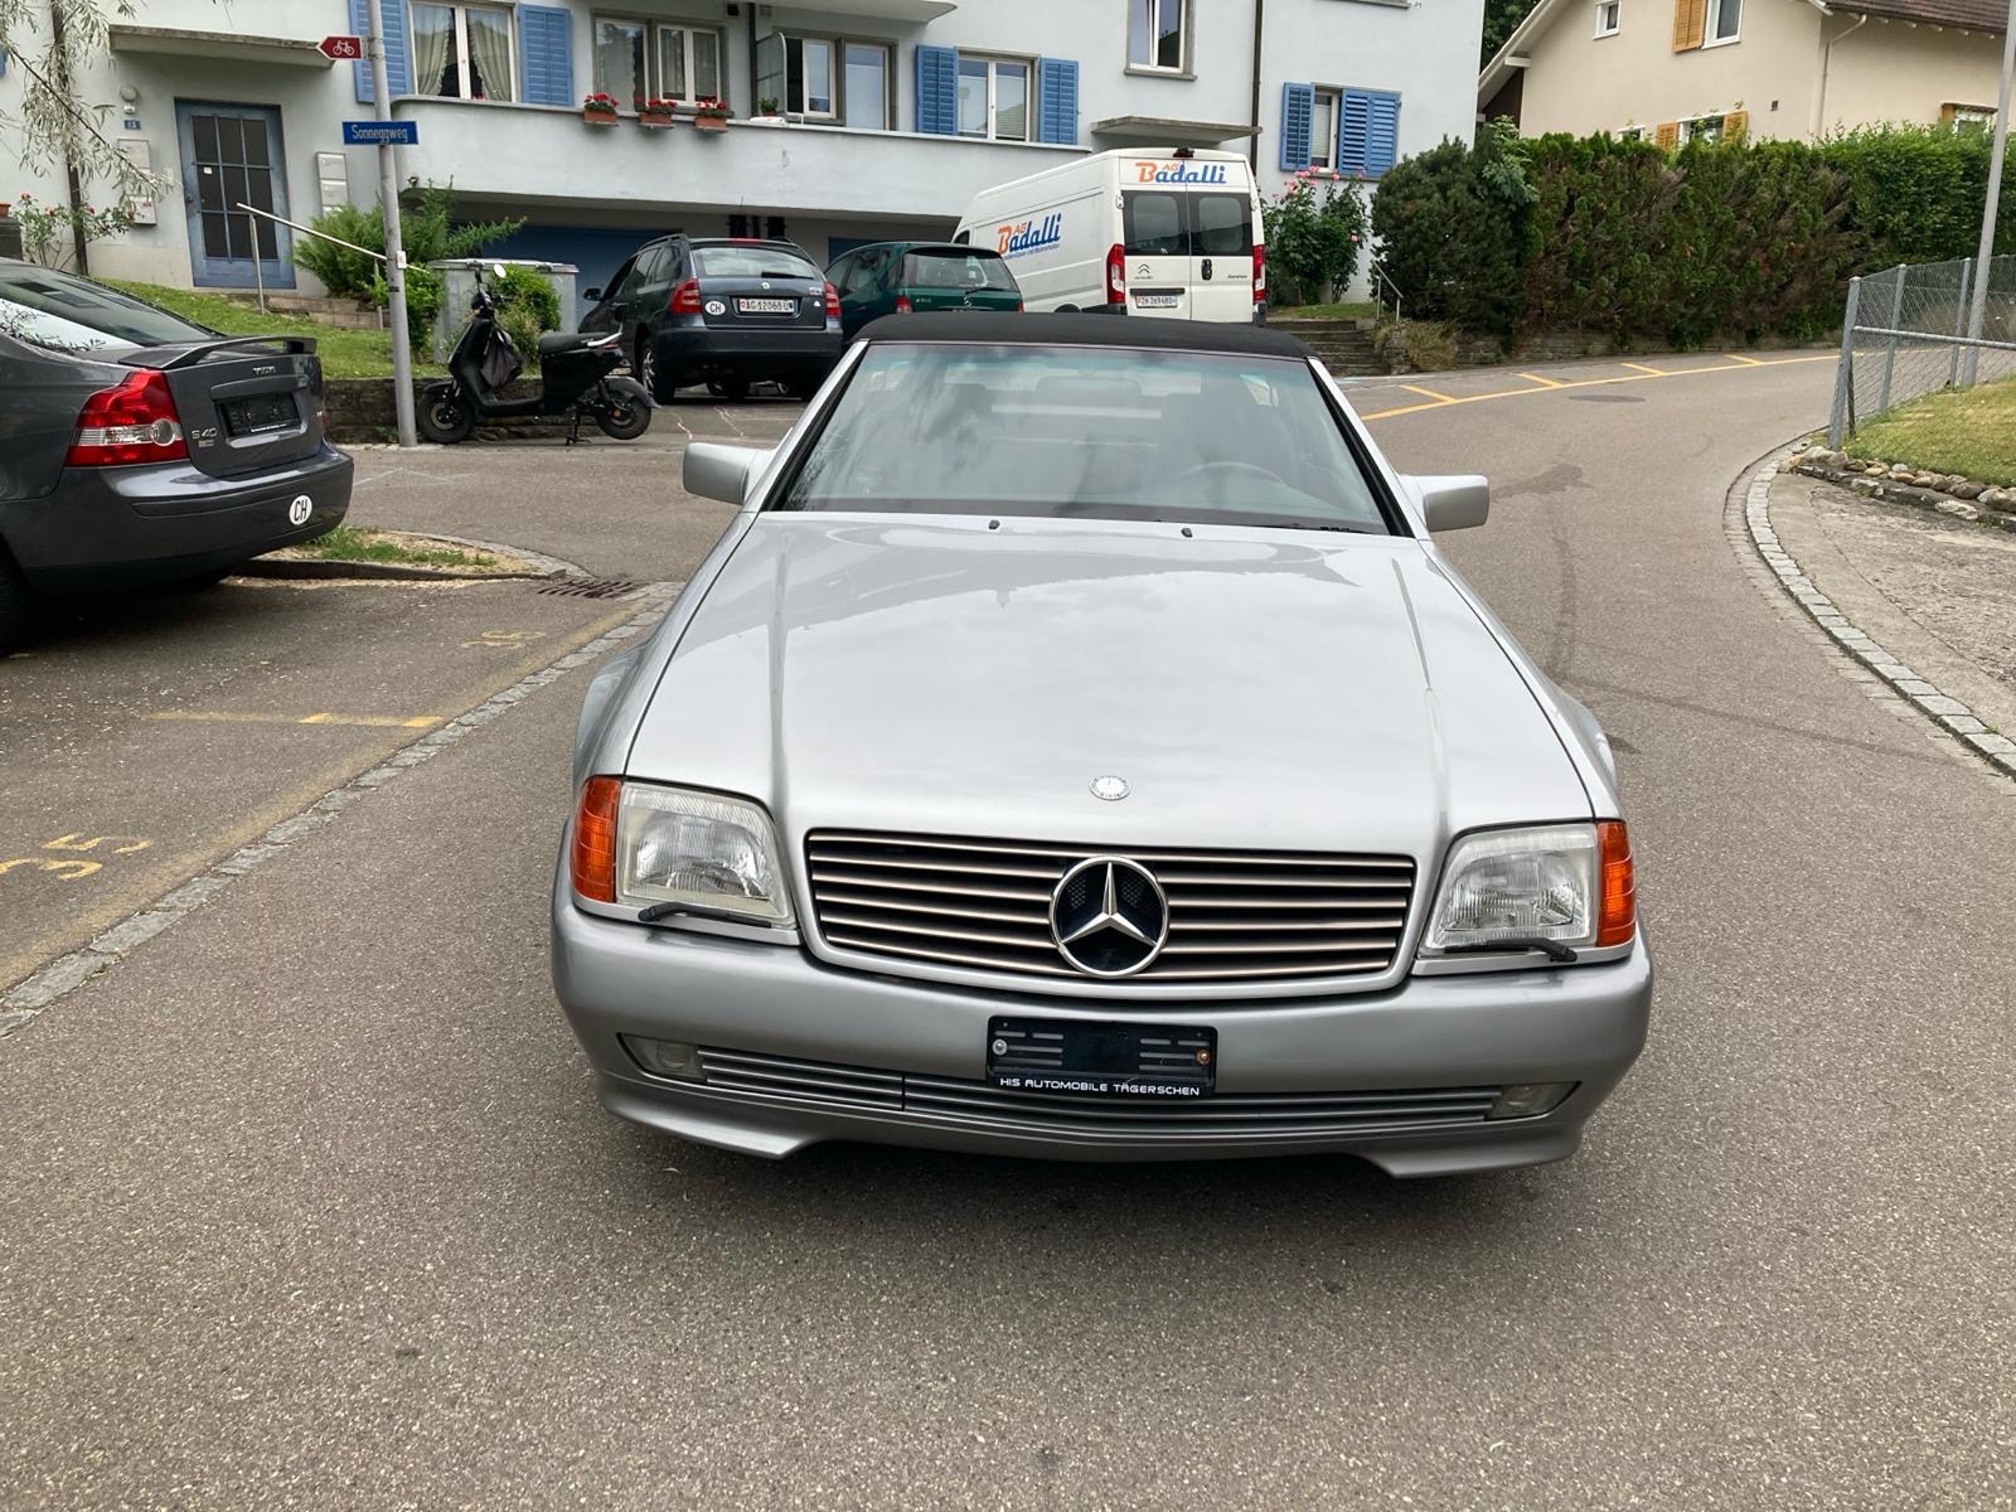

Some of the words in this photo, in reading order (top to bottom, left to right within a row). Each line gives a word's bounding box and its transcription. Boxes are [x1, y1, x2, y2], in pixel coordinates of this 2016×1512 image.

[351, 124, 409, 143] Sonneggweg
[1135, 162, 1226, 184] Badalli
[998, 213, 1061, 254] Badalli
[710, 303, 721, 313] CH
[294, 499, 308, 521] CH
[1000, 1078, 1020, 1087] HIS
[1025, 1079, 1108, 1092] AUTOMOBILE
[1113, 1083, 1200, 1096] TÄGERSCHEN
